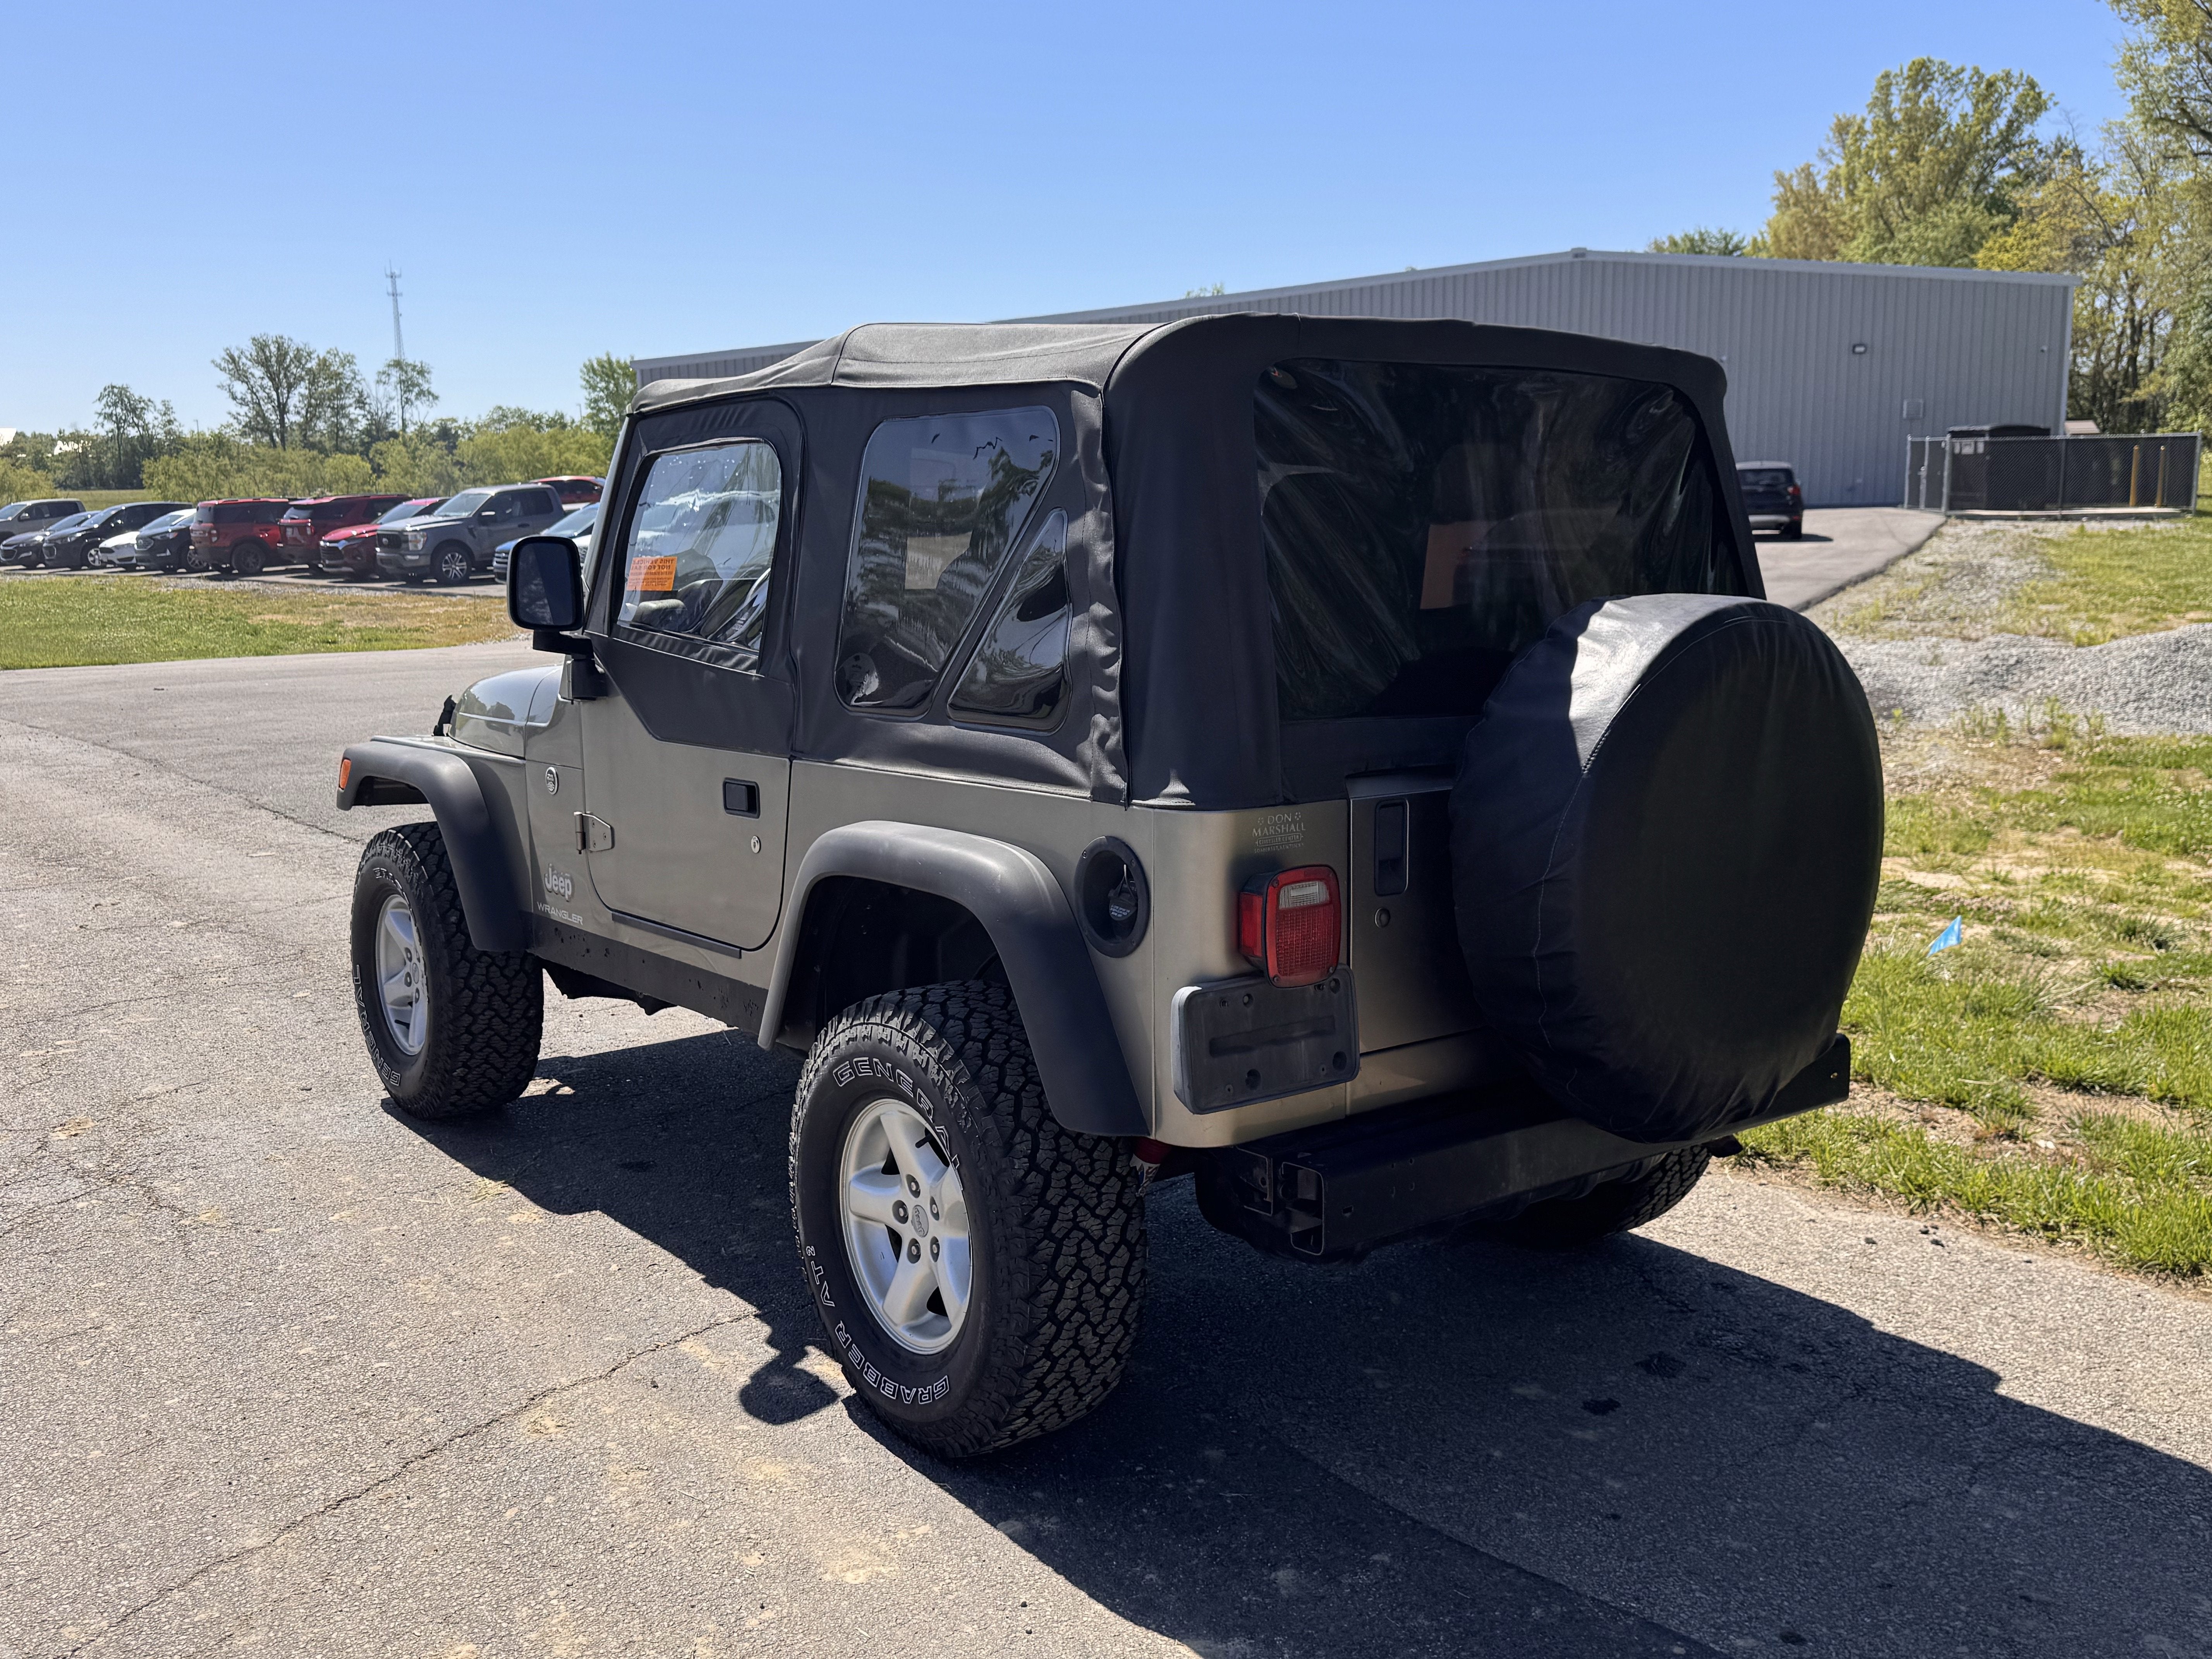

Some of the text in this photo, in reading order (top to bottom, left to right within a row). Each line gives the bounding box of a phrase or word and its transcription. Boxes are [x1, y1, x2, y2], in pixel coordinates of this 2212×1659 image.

[1252, 822, 1306, 837] MARSHALL
[1267, 812, 1291, 824] DON
[544, 864, 573, 902] Jeep
[537, 901, 583, 925] WRANGLER
[353, 964, 401, 1086] GENERAL
[835, 1320, 950, 1405] GRABBER
